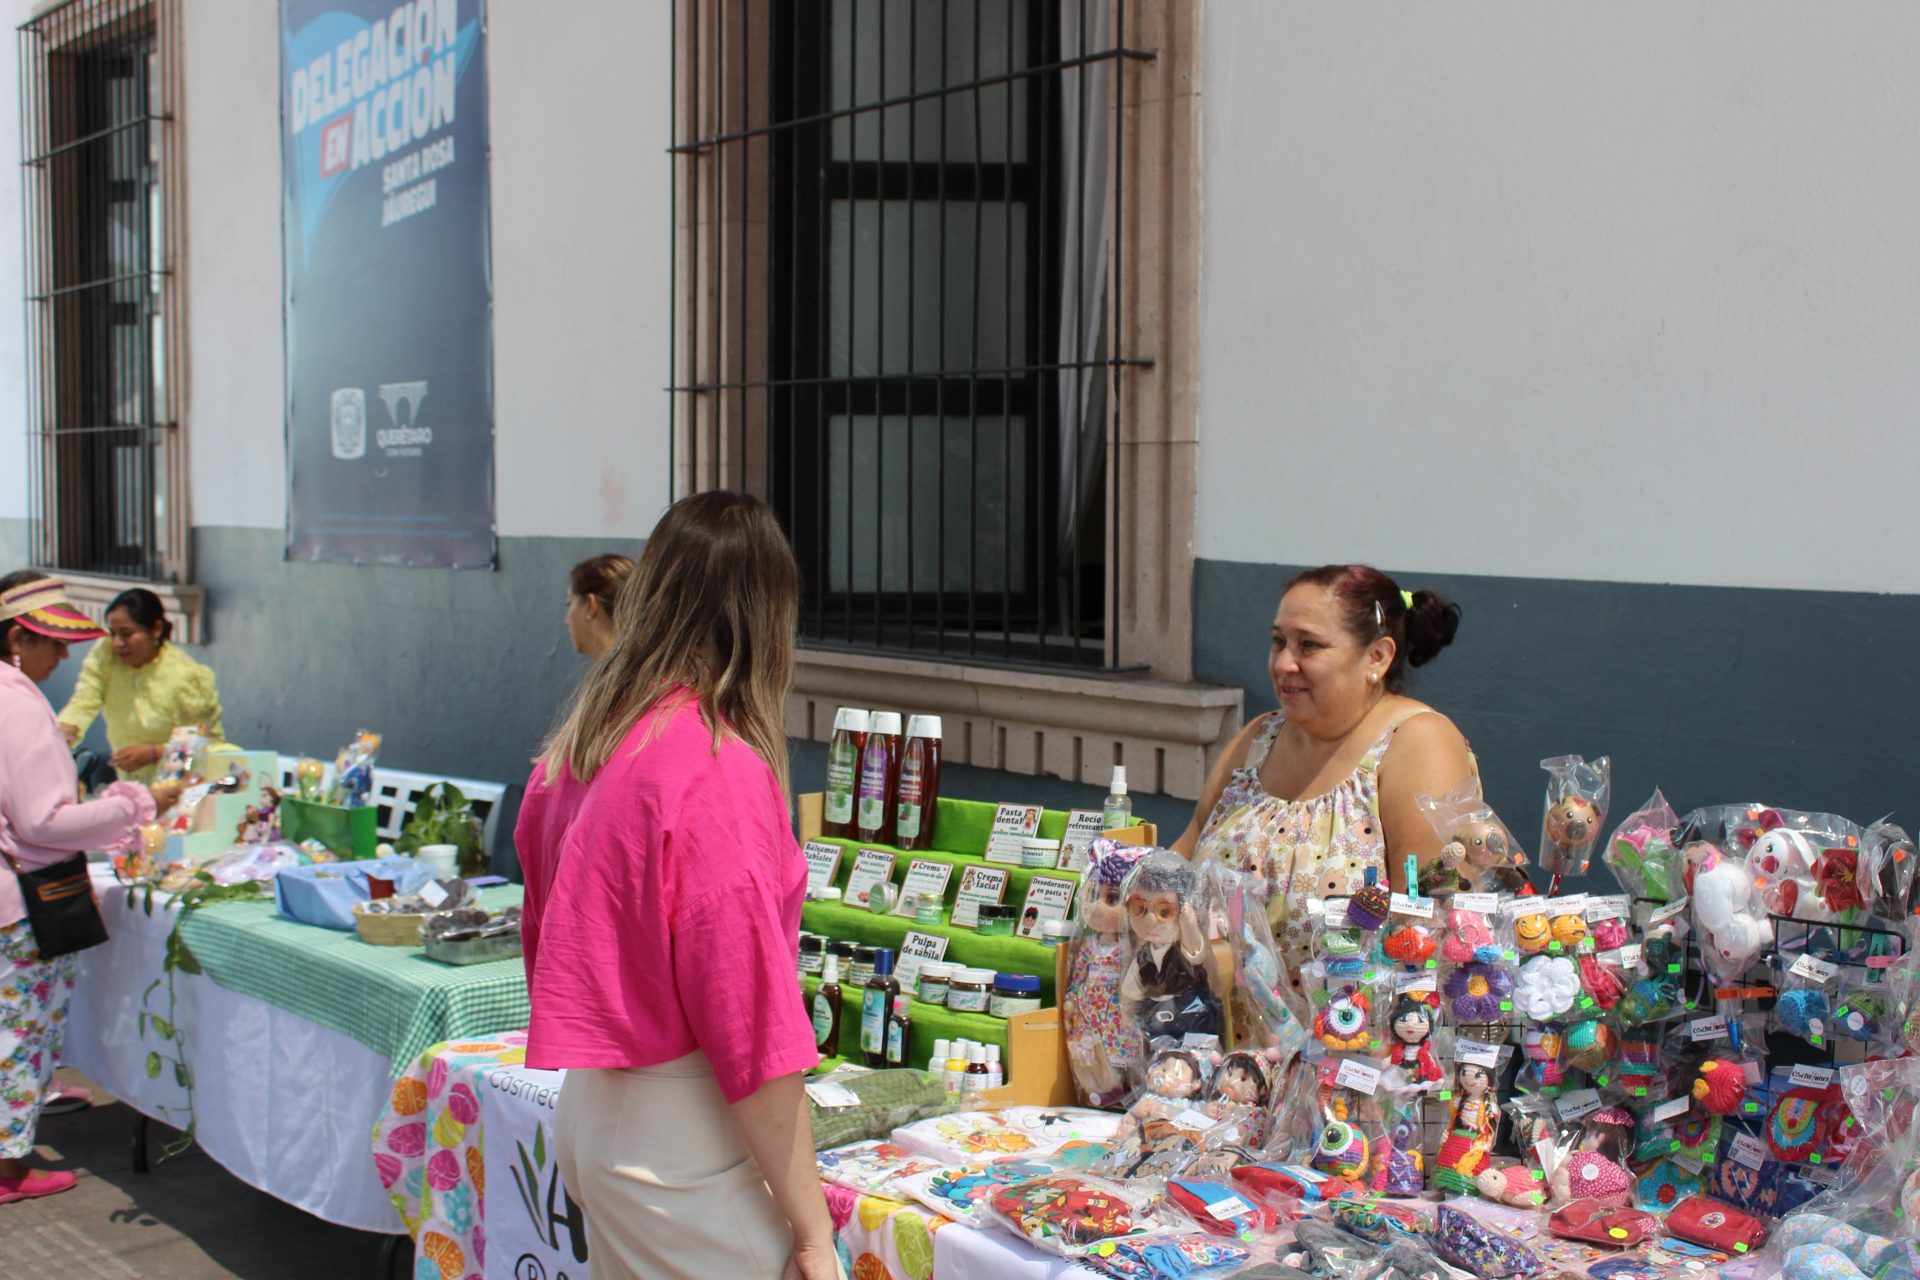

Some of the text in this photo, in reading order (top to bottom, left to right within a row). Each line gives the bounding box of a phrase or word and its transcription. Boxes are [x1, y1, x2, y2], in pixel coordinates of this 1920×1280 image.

[351, 51, 456, 170] ACCIÓN
[382, 134, 455, 194] SANTA ROSA
[1000, 807, 1022, 817] Pasta
[996, 816, 1023, 825] dental
[1078, 814, 1101, 823] Rocío
[867, 852, 893, 862] Cremita
[918, 862, 941, 872] Crema
[976, 872, 1003, 883] Crema
[976, 881, 999, 891] facial
[1032, 878, 1071, 890] Desodorante
[1045, 889, 1062, 897] pasta
[912, 935, 937, 948] Pulpa
[903, 945, 940, 960] de sábila
